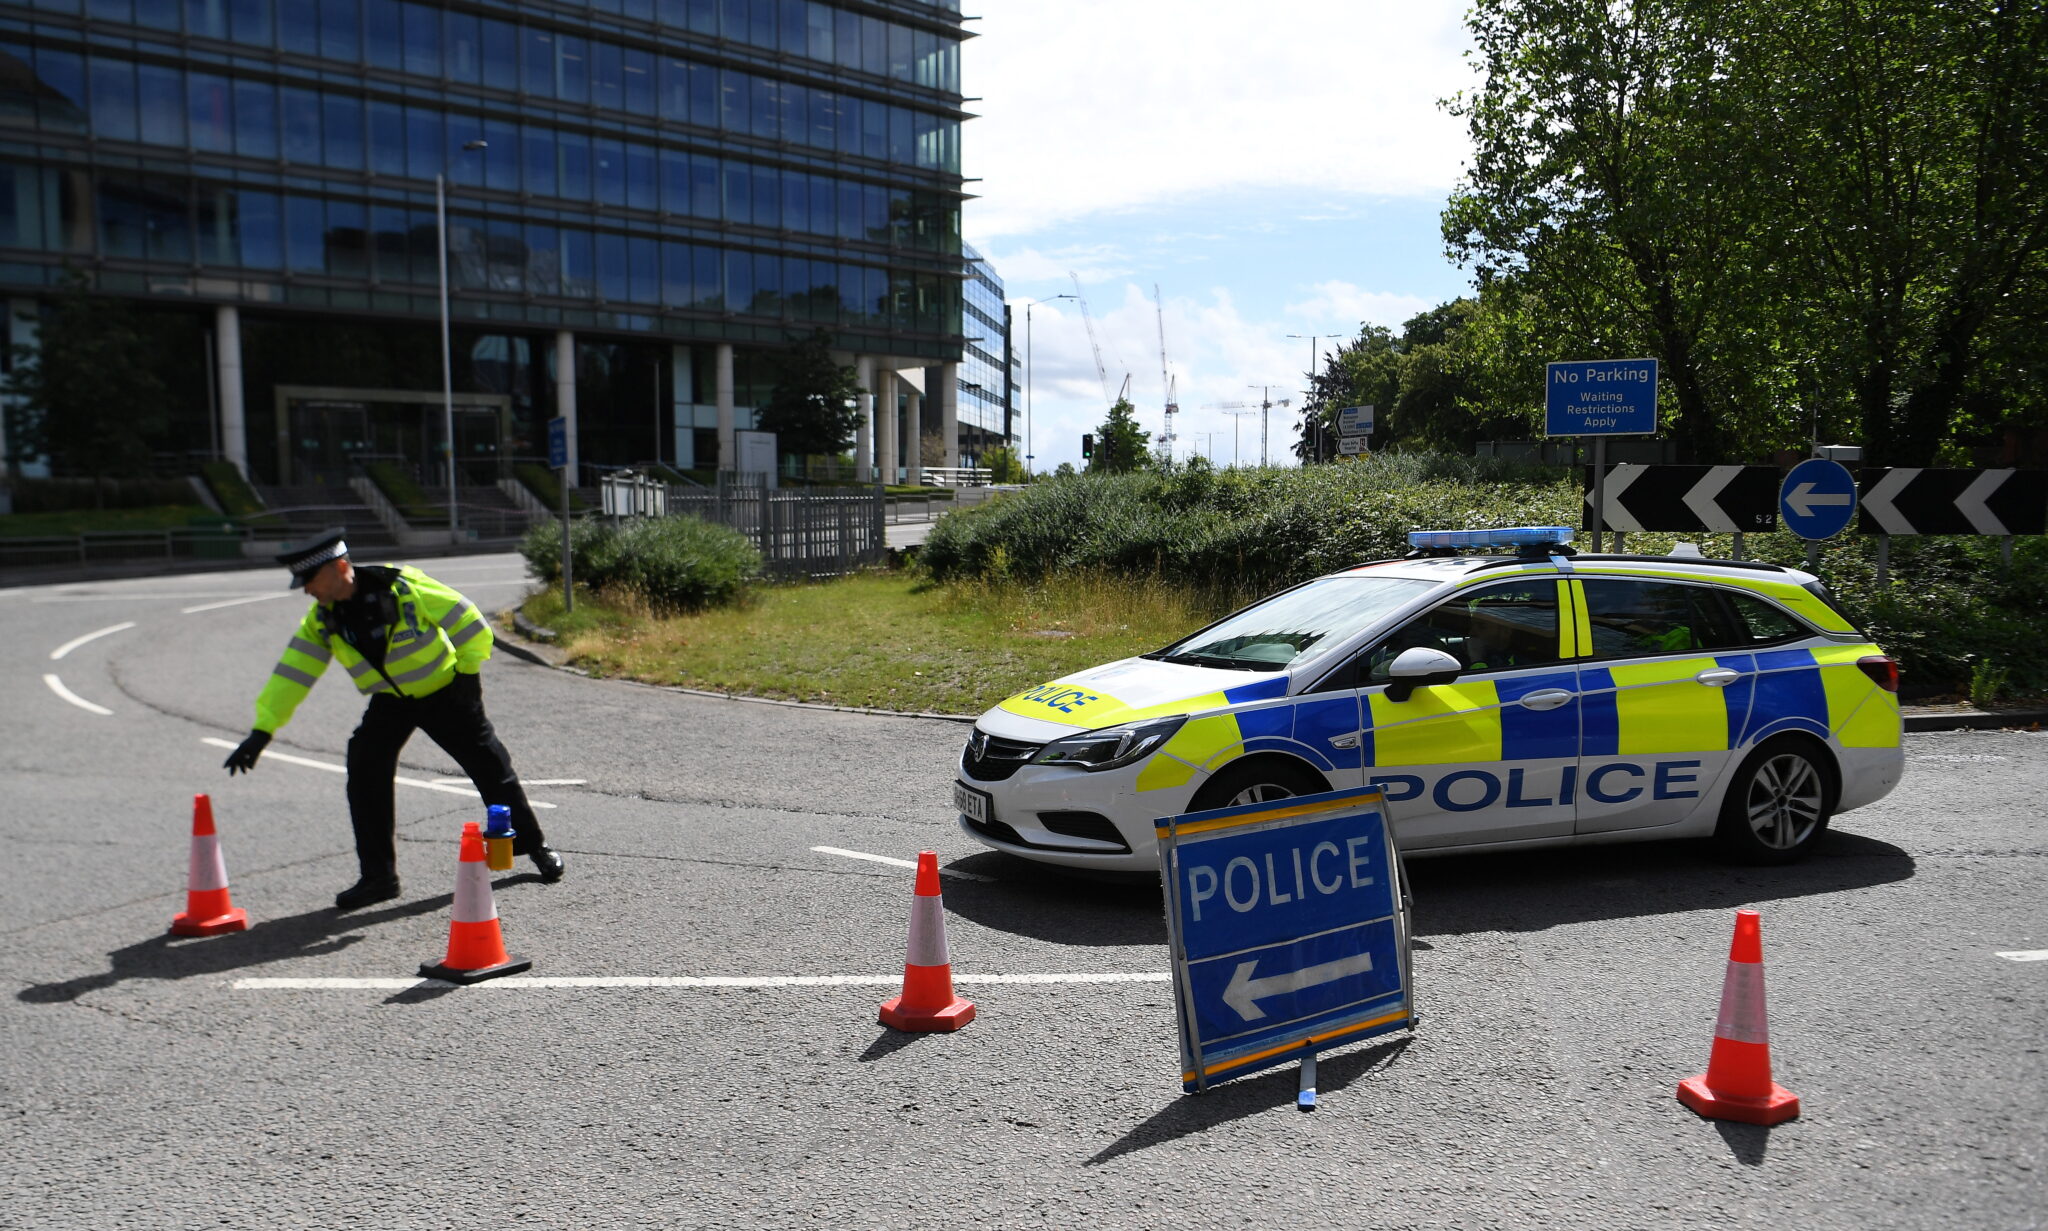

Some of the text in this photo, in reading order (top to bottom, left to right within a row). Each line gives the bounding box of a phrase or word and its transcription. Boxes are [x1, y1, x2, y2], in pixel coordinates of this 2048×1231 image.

[1555, 367, 1649, 384] No Parking
[1580, 391, 1623, 403] Waiting
[1567, 404, 1635, 415] Restrictions
[1584, 416, 1617, 428] Apply
[1016, 685, 1098, 714] POLICE
[1369, 760, 1701, 812] POLICE
[967, 793, 983, 819] ETA
[1188, 836, 1374, 922] POLICE
